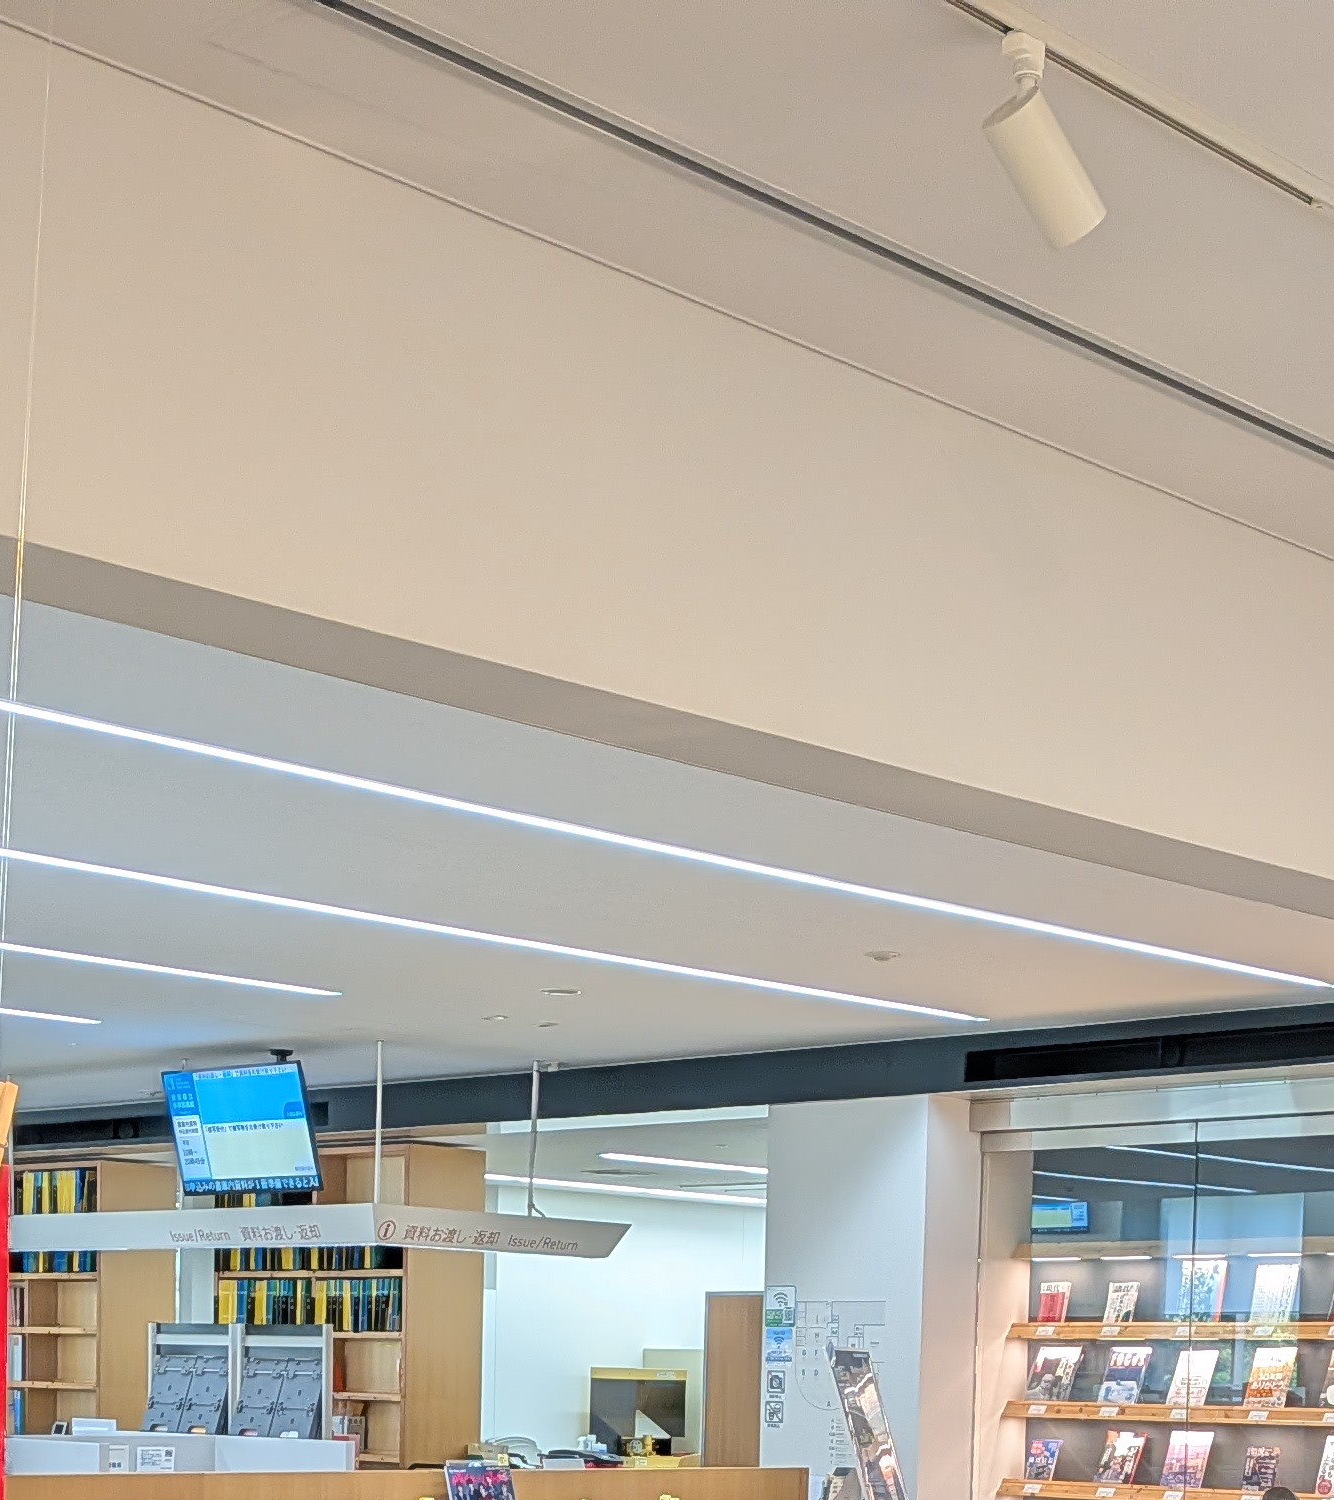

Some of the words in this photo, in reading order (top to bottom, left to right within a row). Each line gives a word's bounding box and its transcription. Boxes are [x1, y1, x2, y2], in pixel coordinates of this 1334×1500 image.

[169, 1229, 230, 1242] Issue/Return
[404, 1224, 499, 1246] 資料お渡し・返却
[507, 1235, 579, 1251] Issue/Return
